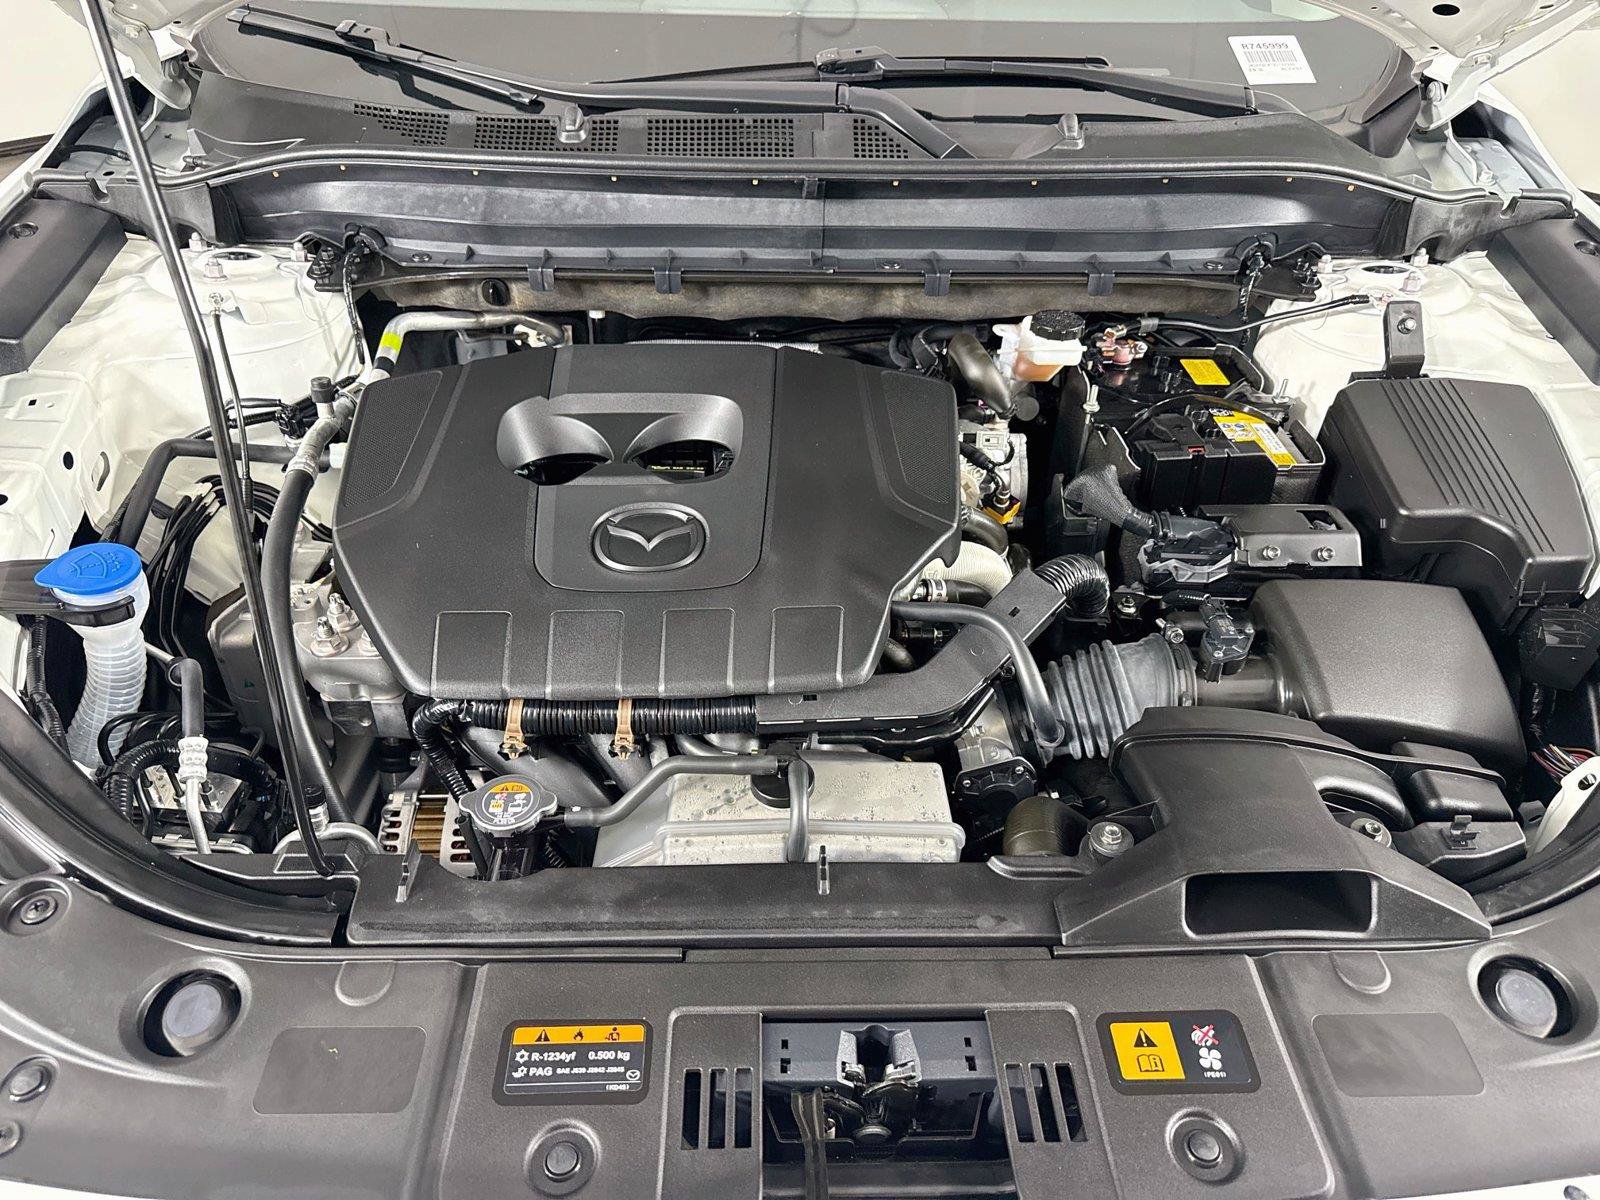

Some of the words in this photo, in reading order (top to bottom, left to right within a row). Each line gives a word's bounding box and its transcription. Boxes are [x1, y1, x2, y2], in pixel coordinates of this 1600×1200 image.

[531, 1051, 576, 1062] R-1234yf
[588, 1051, 615, 1060] 0.500
[617, 1050, 631, 1061] kg
[529, 1067, 553, 1076] PAG
